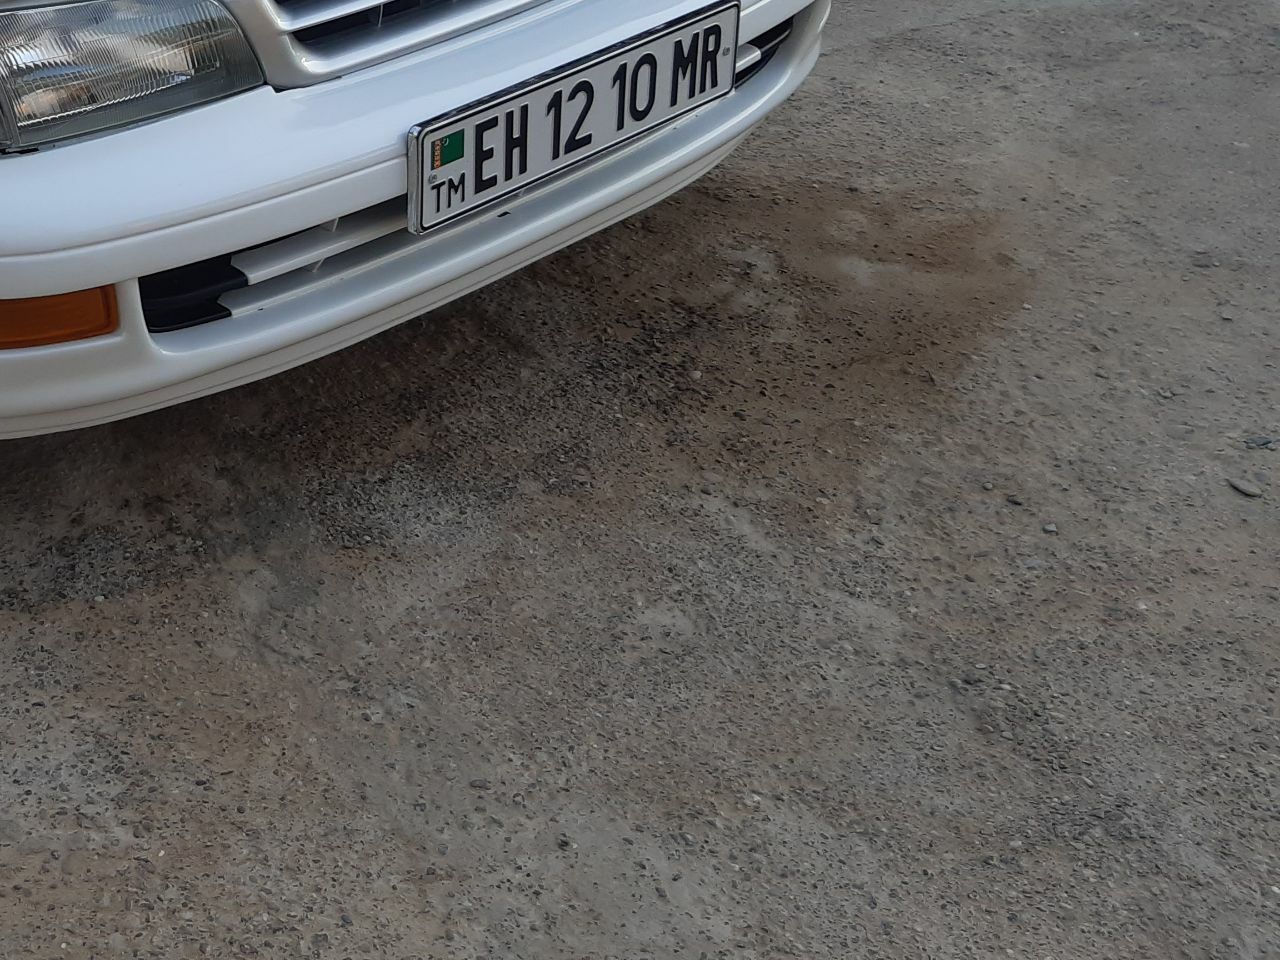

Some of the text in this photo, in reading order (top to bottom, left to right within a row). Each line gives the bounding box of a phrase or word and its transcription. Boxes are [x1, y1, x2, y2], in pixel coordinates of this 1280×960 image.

[474, 24, 722, 195] EH 12 10 MR
[431, 171, 466, 214] TM
